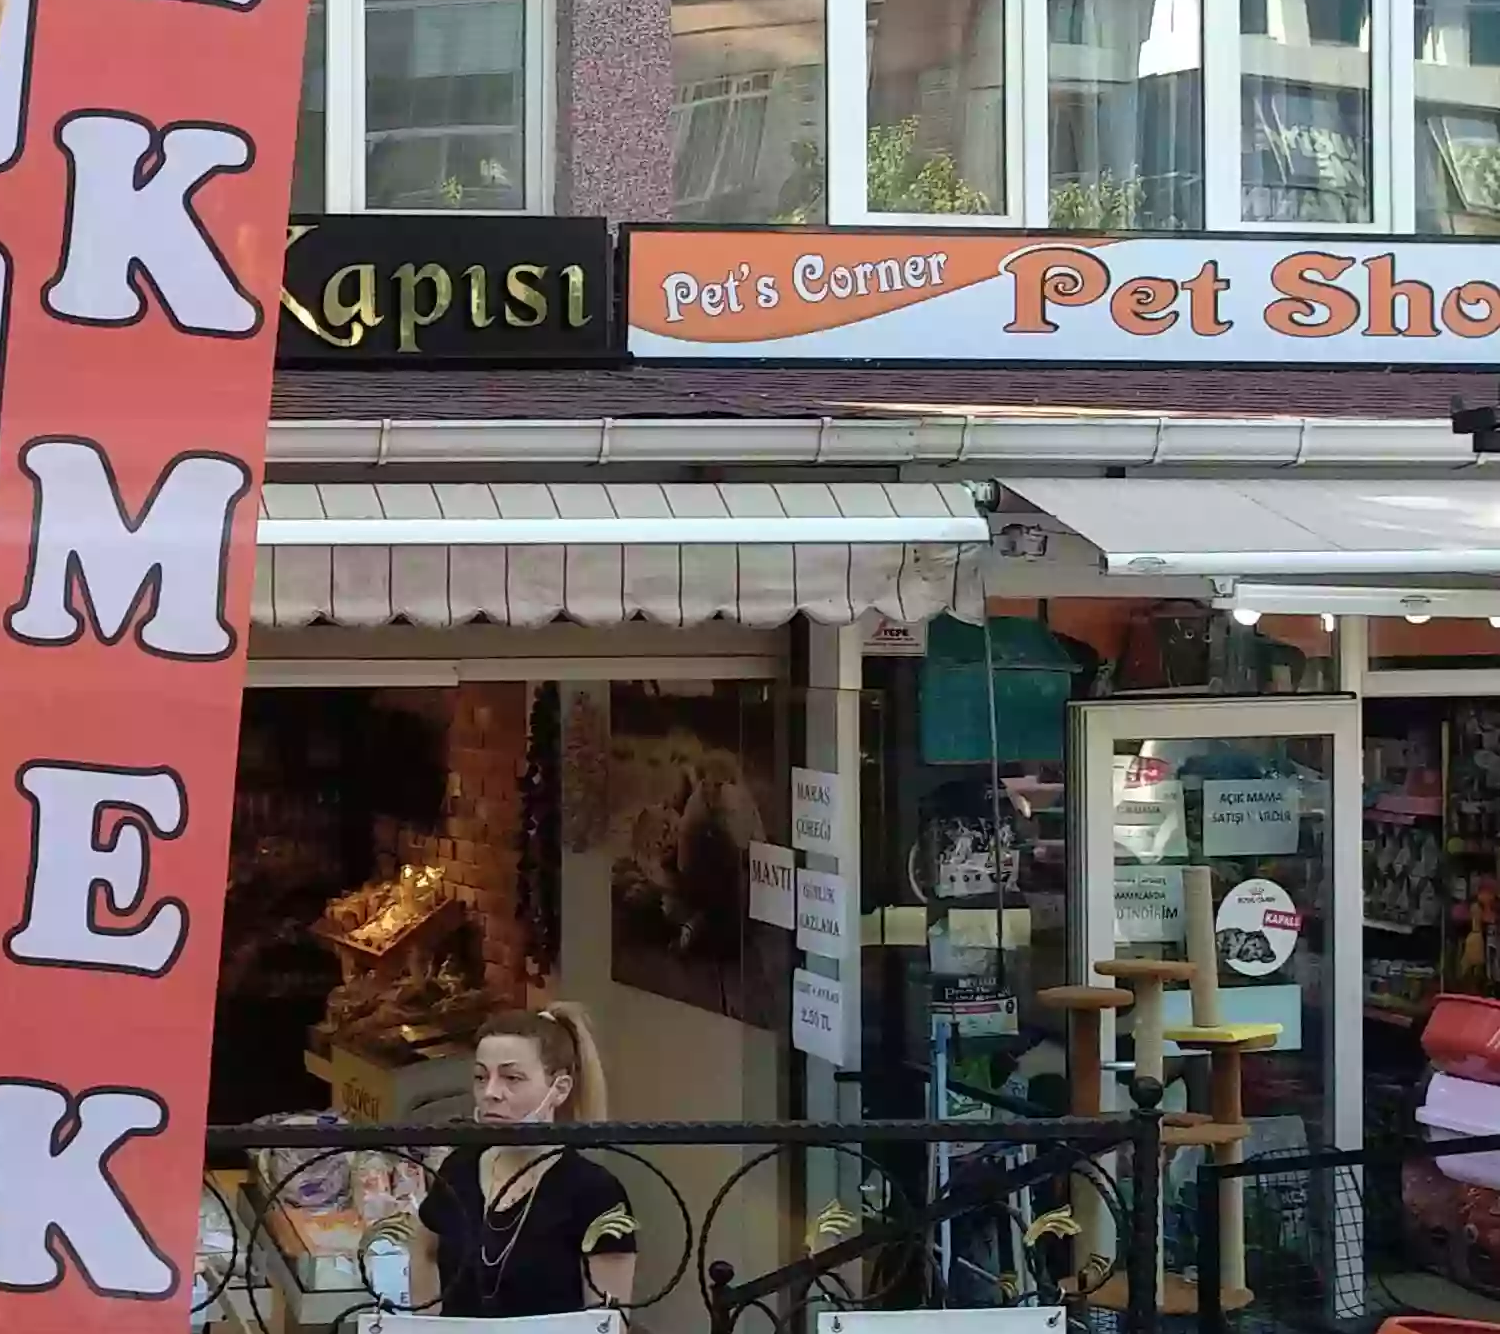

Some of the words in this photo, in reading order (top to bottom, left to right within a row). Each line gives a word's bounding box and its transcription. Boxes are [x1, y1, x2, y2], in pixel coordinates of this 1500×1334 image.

[662, 263, 779, 324] Pet's
[791, 249, 951, 309] Corner
[999, 244, 1236, 337] Pet
[1263, 250, 1500, 339] Sho
[751, 858, 793, 892] MANTI
